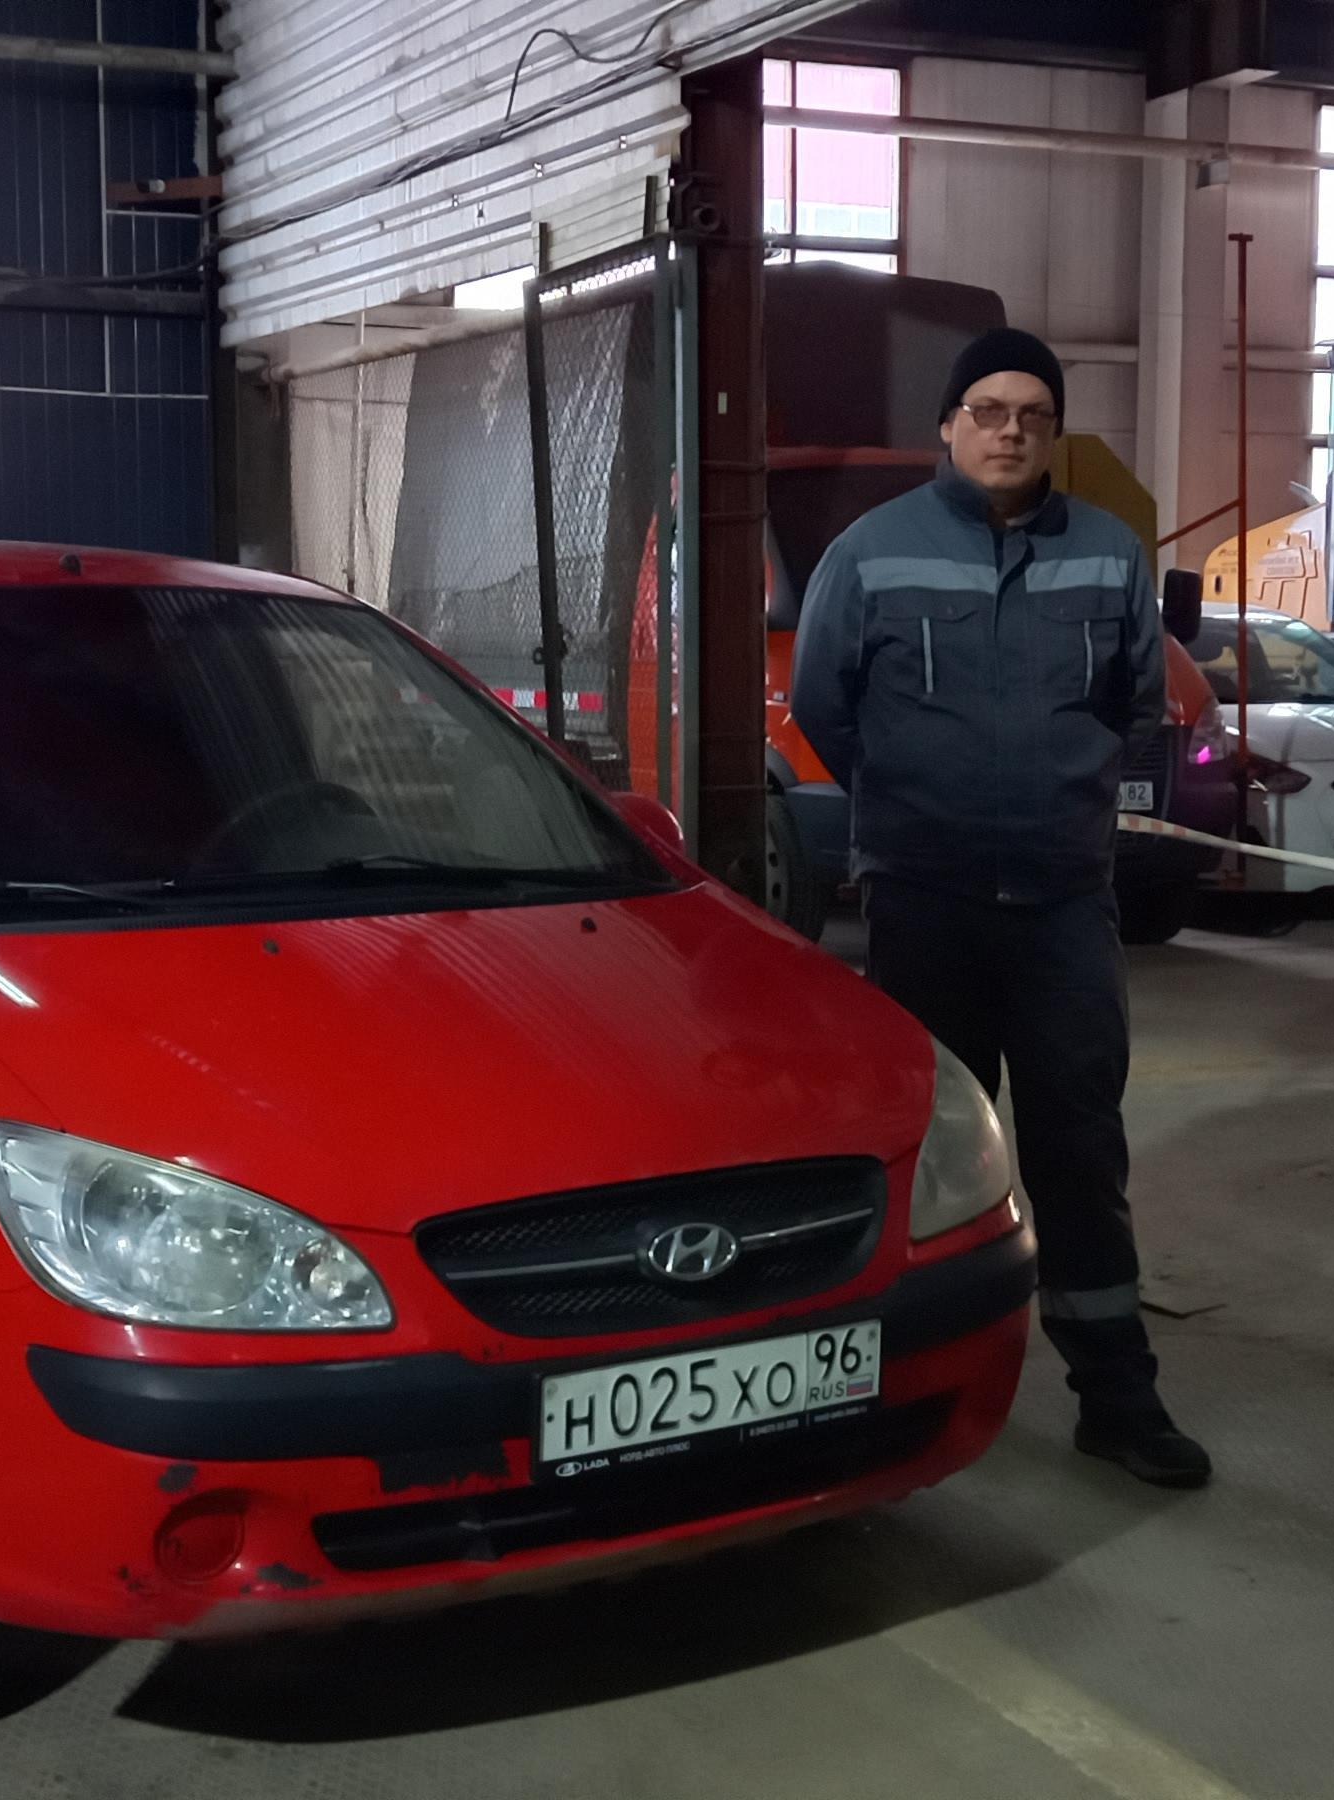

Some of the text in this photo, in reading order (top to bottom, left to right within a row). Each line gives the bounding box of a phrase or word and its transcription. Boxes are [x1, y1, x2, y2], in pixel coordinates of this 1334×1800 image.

[1127, 783, 1147, 801] 82
[813, 1327, 862, 1381] 96
[808, 1380, 845, 1403] RUS
[583, 1457, 610, 1471] LADA
